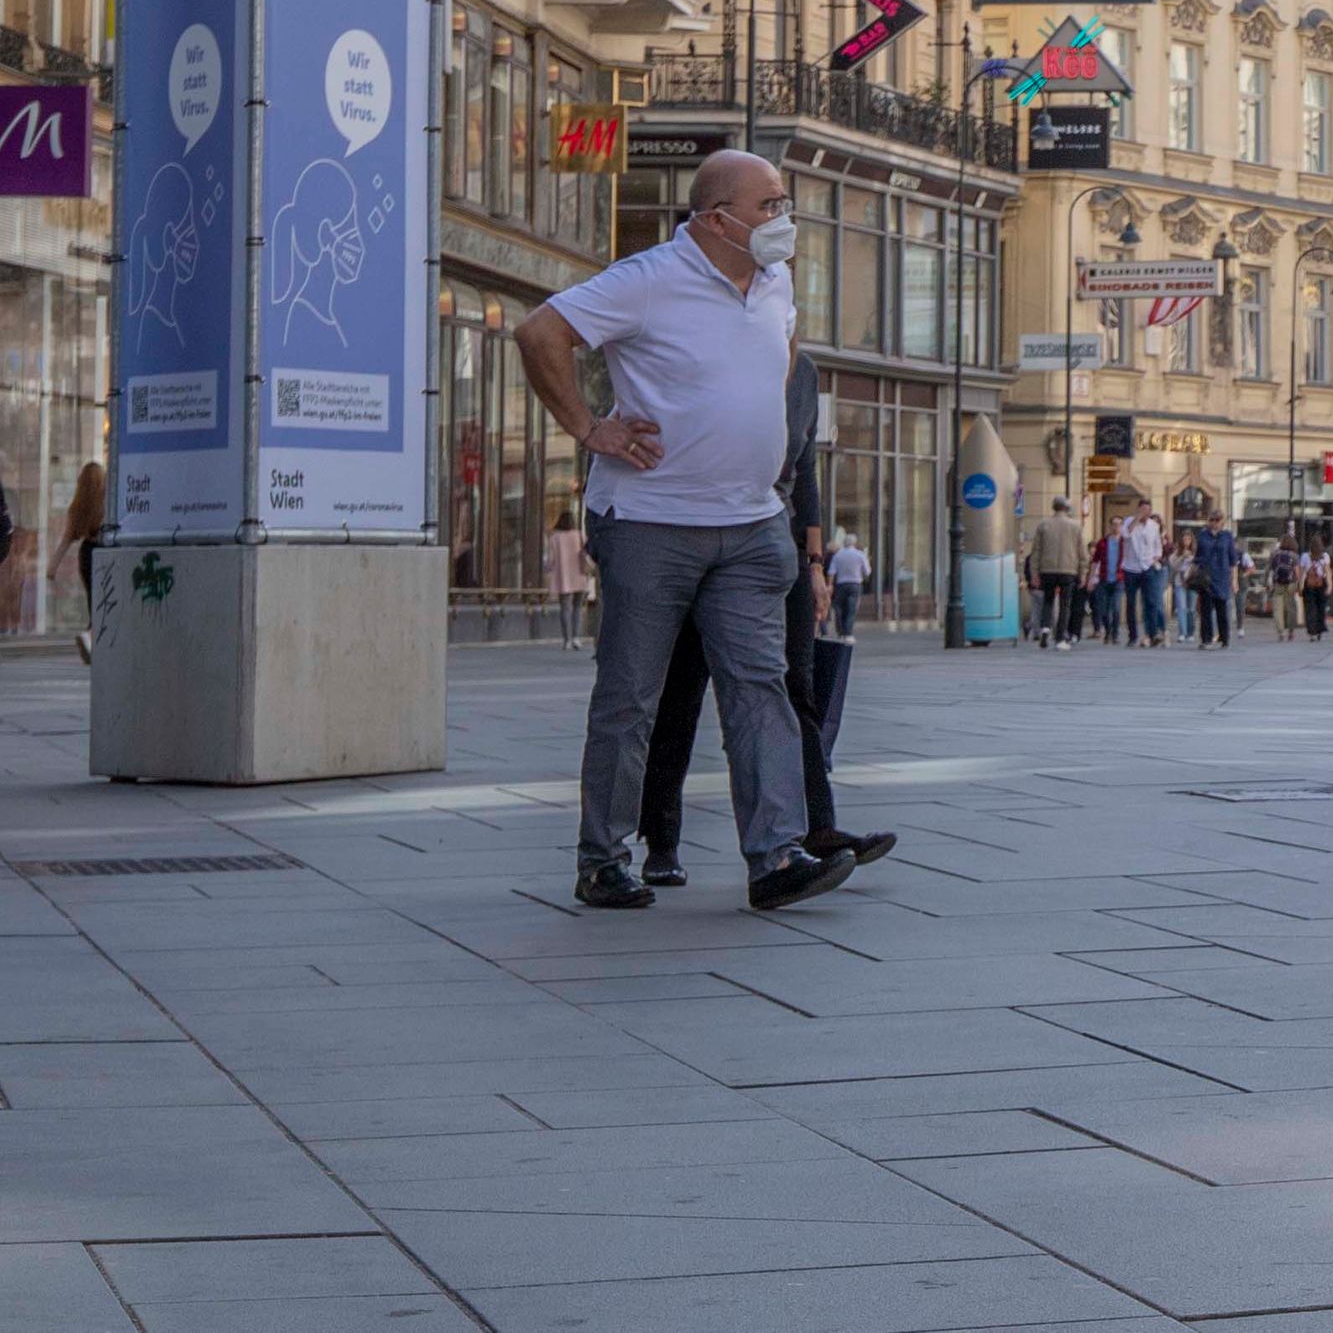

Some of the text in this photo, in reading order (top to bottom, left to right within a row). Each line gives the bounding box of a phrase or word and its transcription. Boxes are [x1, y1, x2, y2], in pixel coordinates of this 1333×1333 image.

[185, 45, 205, 65] Wir
[347, 50, 371, 70] Wir
[183, 73, 208, 92] statt
[344, 78, 374, 96] statt
[180, 98, 210, 118] Virus.
[340, 100, 377, 123] Virus.
[126, 474, 151, 494] Stadt
[270, 469, 305, 488] Stadt
[125, 495, 151, 515] Wien
[269, 490, 304, 511] Wien
